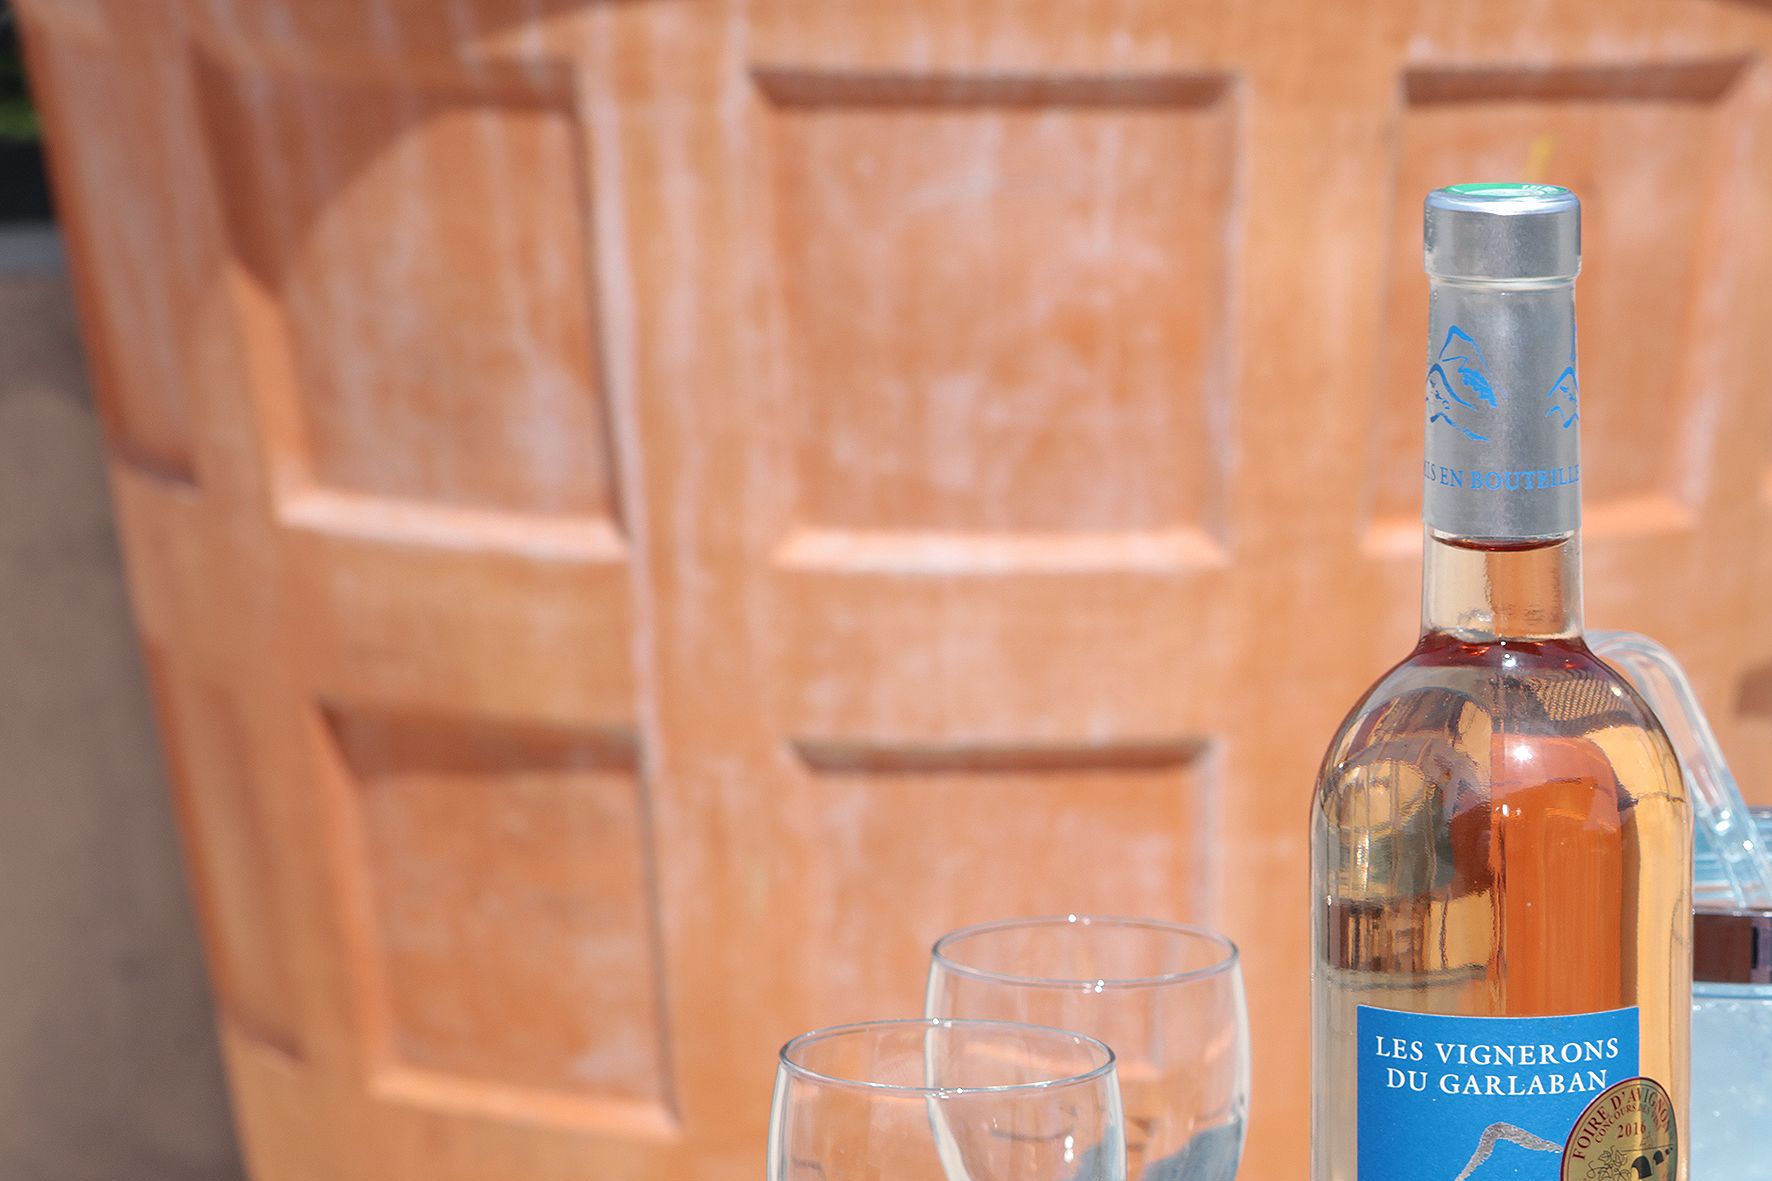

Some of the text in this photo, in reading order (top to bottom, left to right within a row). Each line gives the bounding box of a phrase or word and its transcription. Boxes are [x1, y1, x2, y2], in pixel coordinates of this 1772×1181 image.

[1440, 466, 1465, 489] EN
[1376, 1036, 1619, 1066] LES VIGNERONS
[1386, 1067, 1607, 1096] DU GARLABAN
[1572, 1106, 1607, 1159] FOIRE
